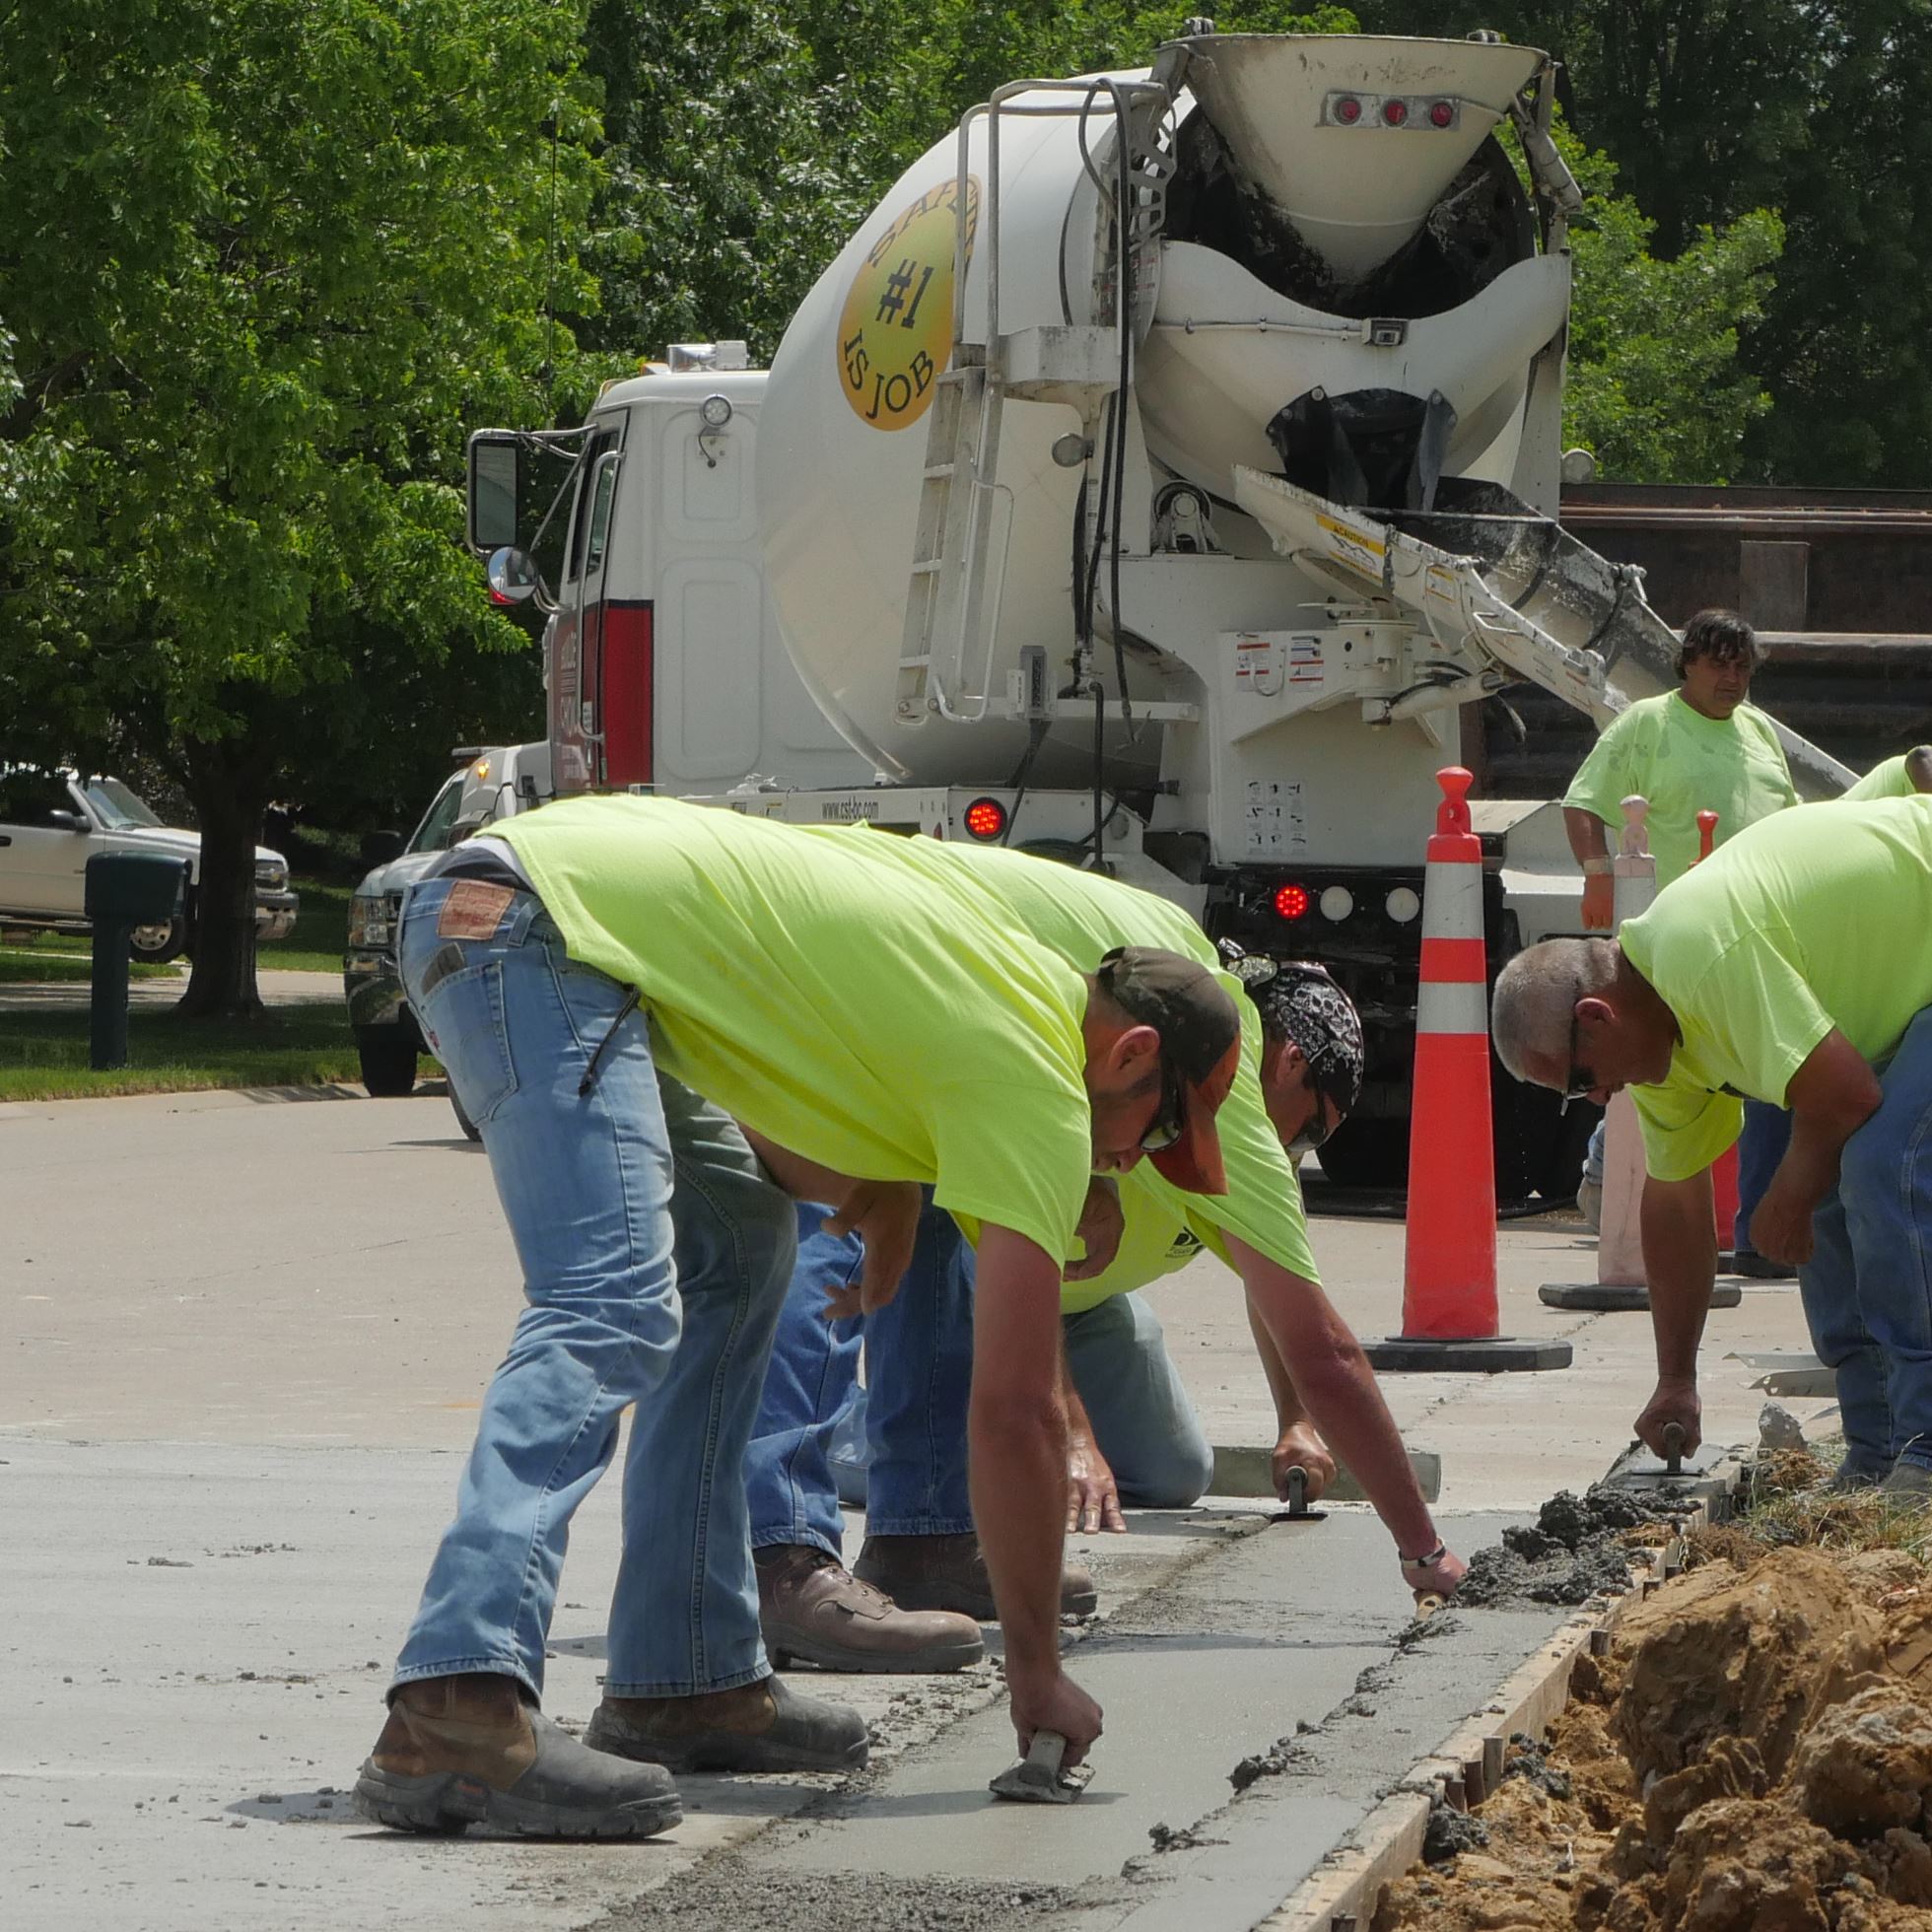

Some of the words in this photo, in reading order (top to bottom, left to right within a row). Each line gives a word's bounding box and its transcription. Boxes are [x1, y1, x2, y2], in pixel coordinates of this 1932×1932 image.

[875, 258, 933, 328] #1
[844, 328, 869, 390] IS
[865, 350, 933, 420] JOB
